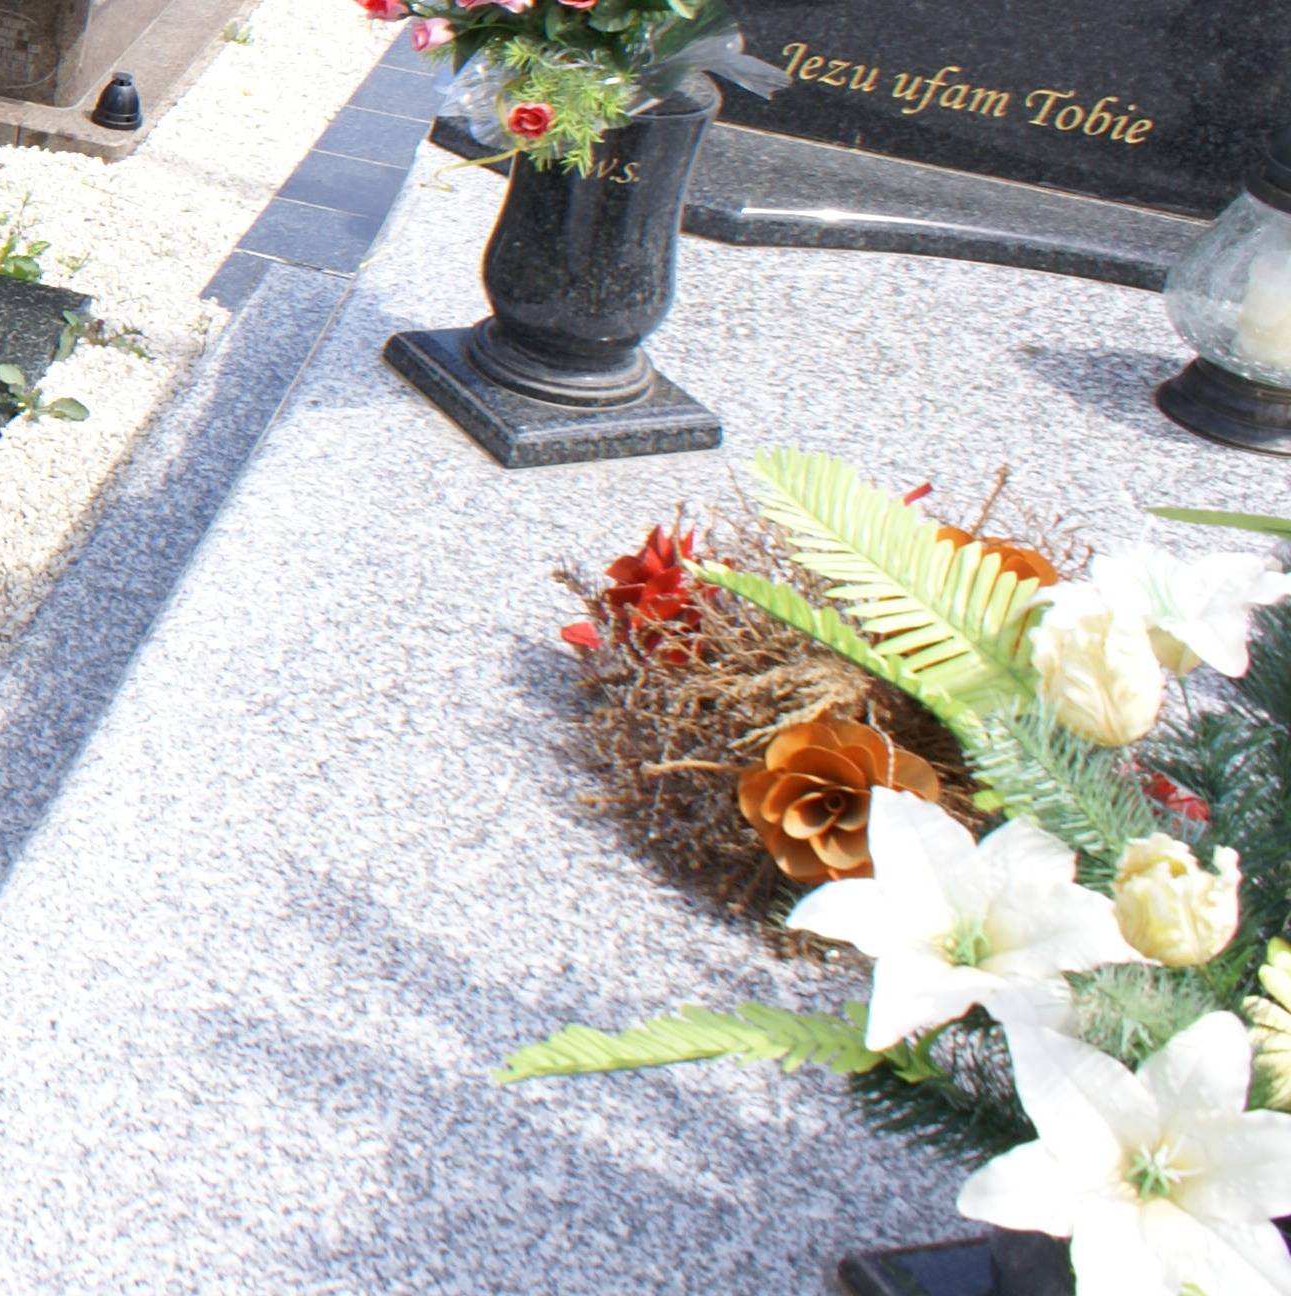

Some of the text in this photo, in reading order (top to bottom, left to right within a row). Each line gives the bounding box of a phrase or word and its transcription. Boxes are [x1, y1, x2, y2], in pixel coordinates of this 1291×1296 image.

[781, 41, 1154, 144] Jezu ufam Tobie
